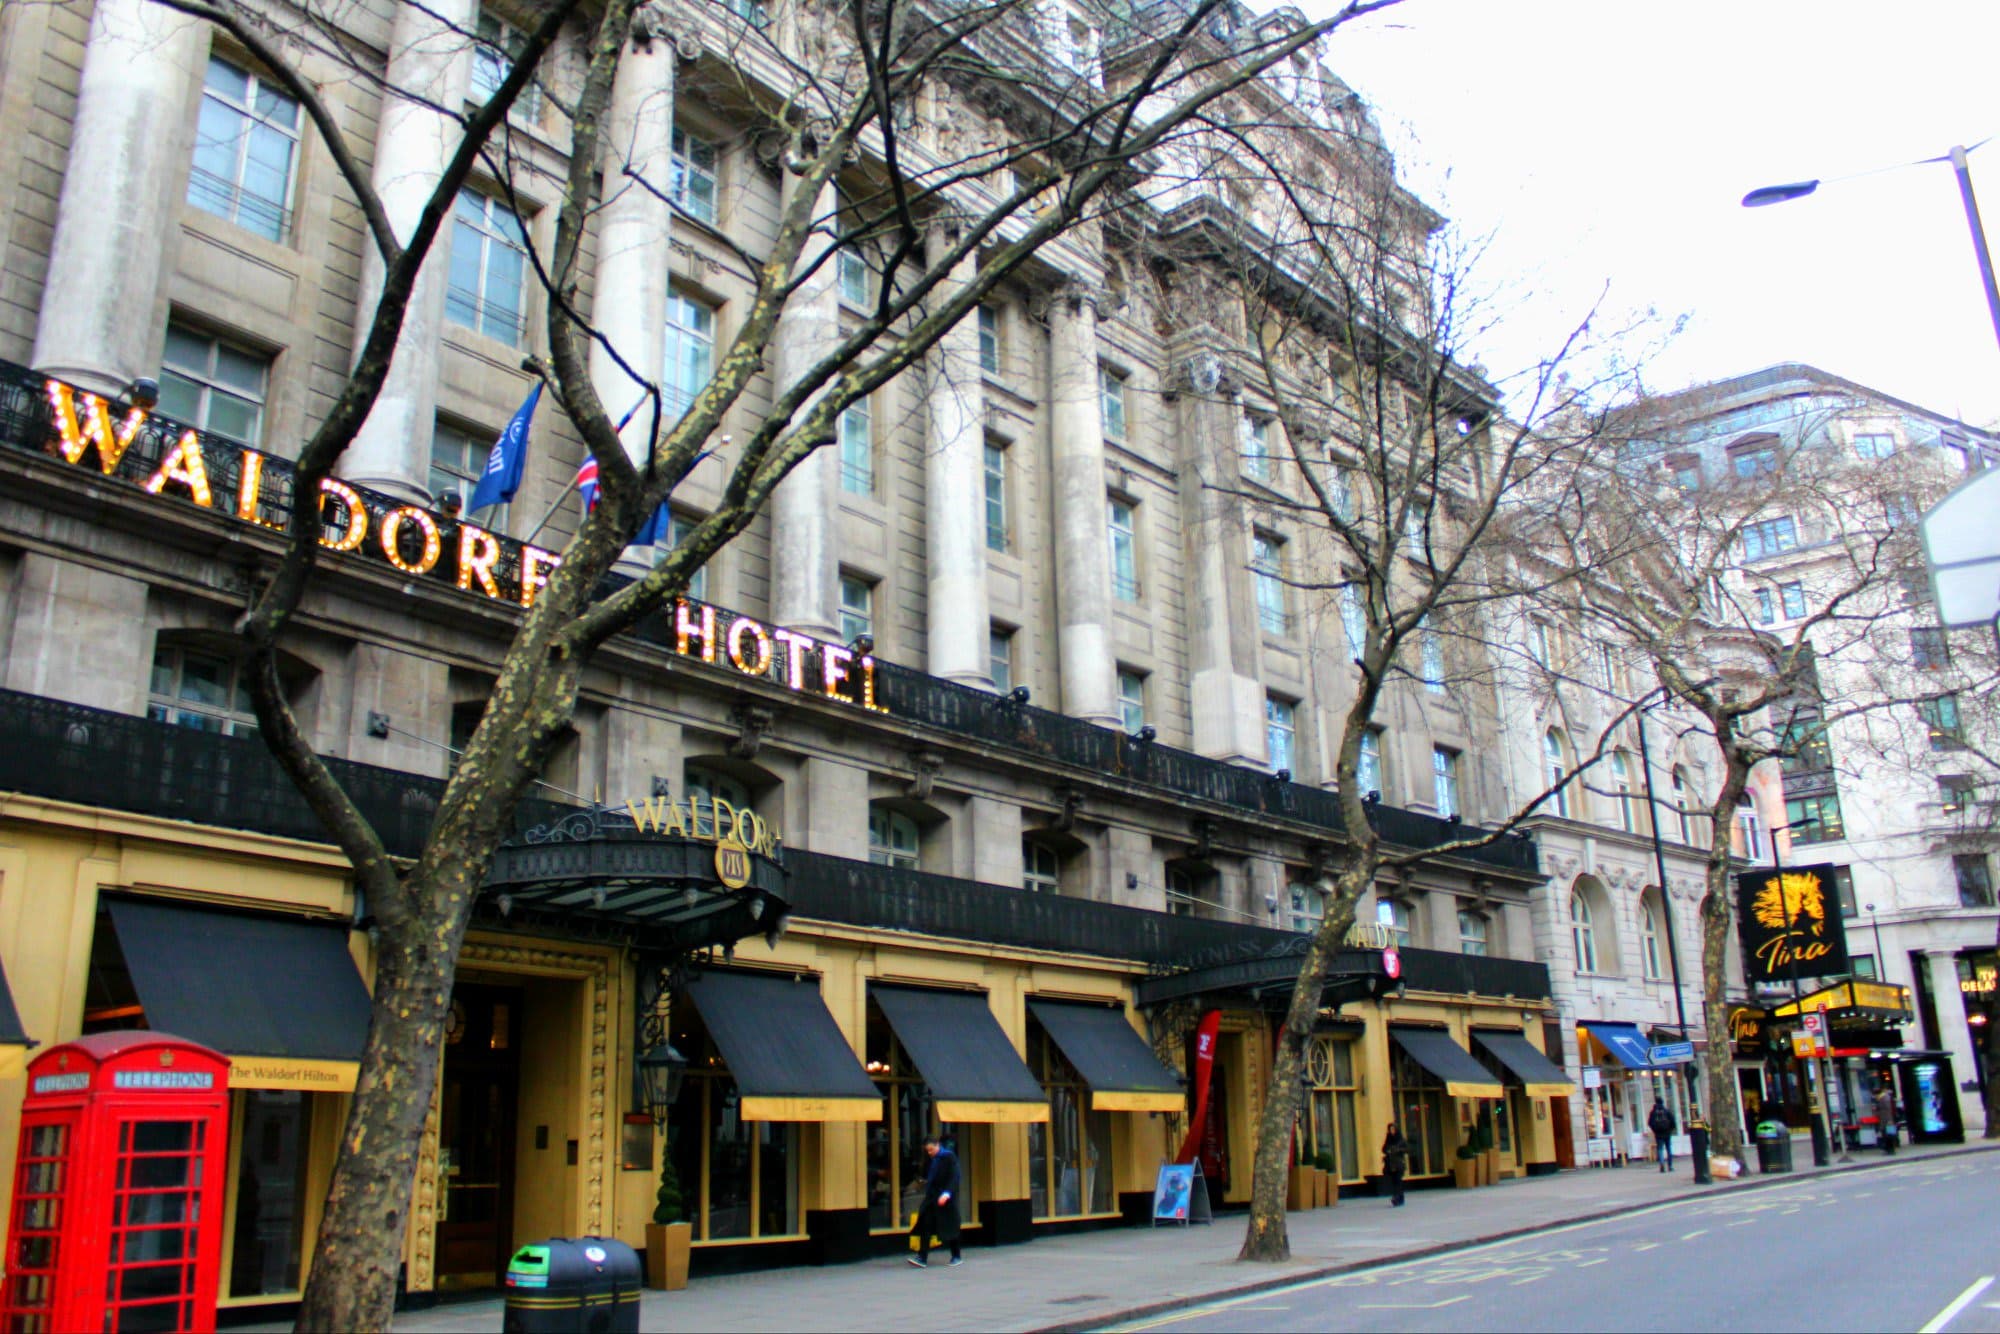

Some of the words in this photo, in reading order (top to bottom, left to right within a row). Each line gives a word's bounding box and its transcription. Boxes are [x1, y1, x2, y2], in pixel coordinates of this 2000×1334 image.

[46, 378, 562, 609] WALDORF
[675, 597, 890, 715] HOTEL
[1756, 930, 1835, 973] Tina
[117, 1072, 211, 1088] TELEPHONE
[229, 1066, 250, 1078] The
[253, 1067, 301, 1080] Waldorf
[304, 1069, 340, 1082] Hilton
